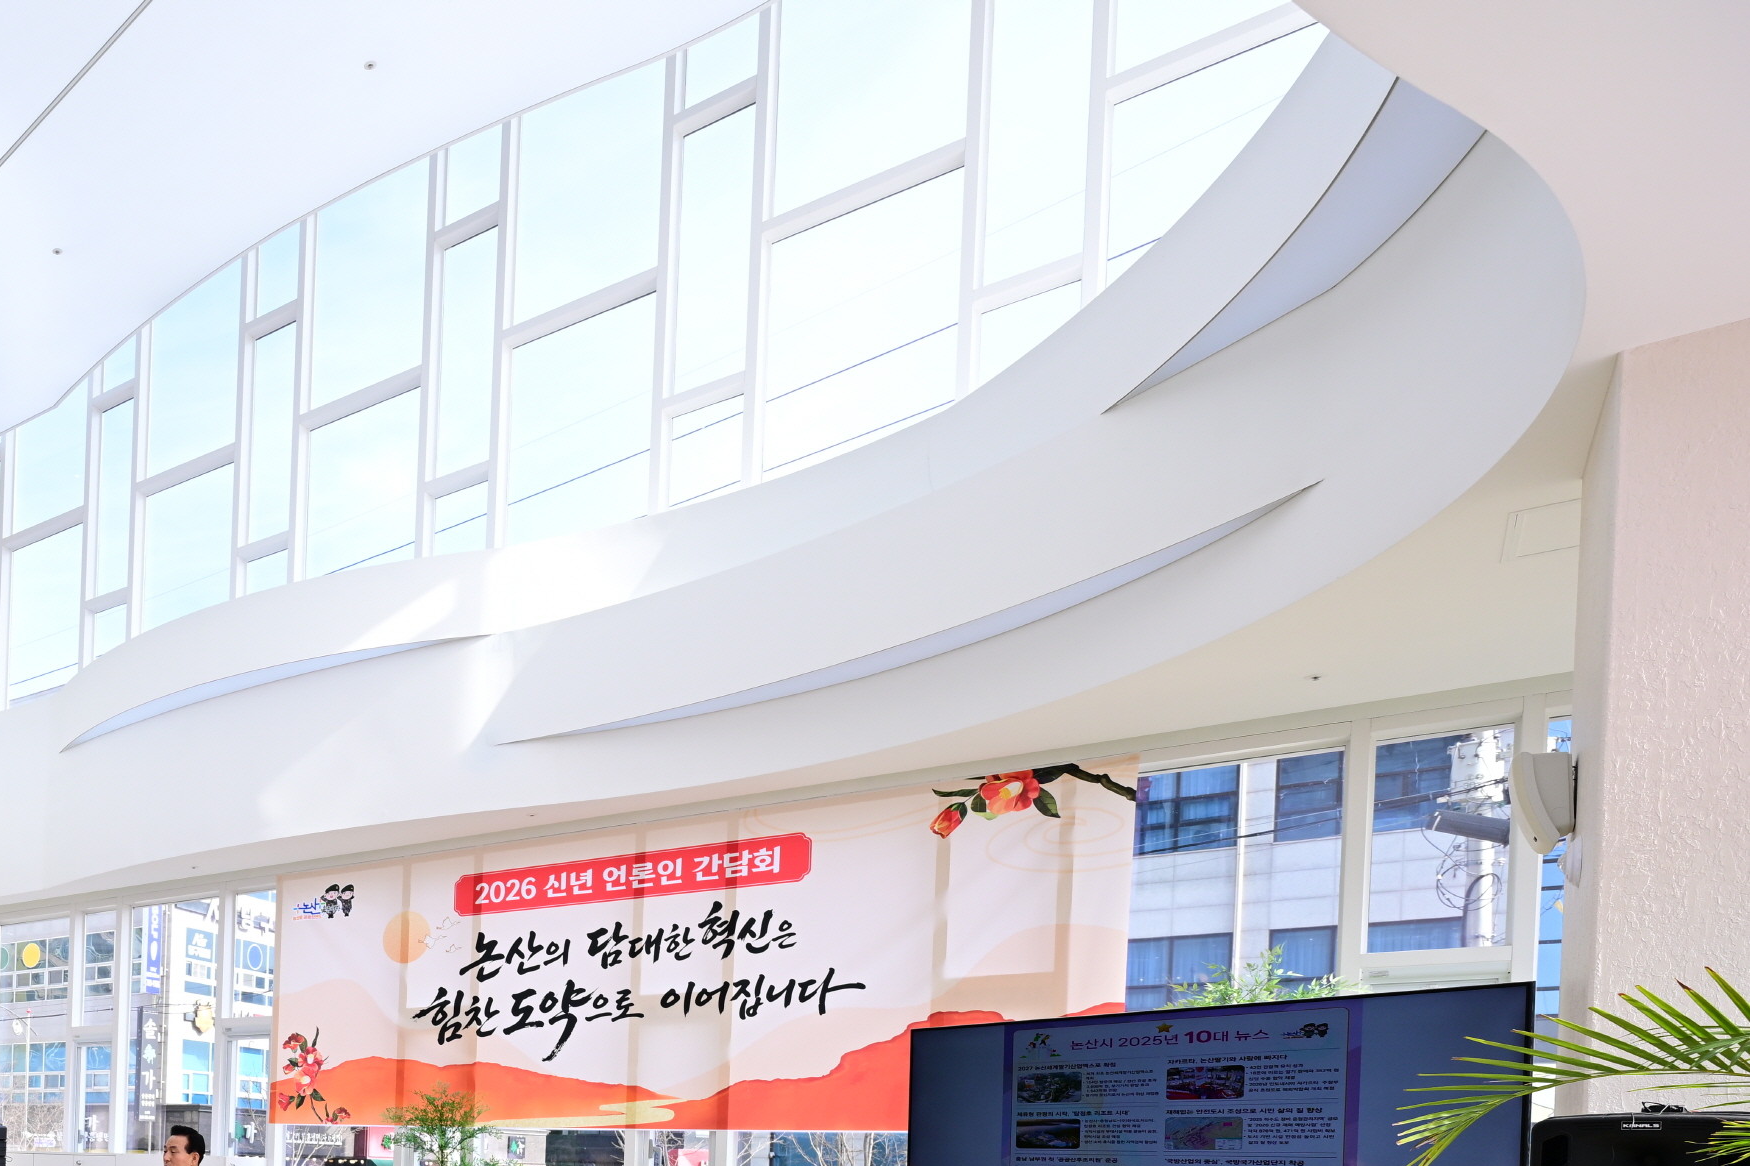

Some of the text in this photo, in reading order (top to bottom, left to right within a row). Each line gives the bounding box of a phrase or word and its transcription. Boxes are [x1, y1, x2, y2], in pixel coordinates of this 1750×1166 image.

[475, 847, 782, 907] 2026 신년 언론인 간담회
[460, 899, 798, 980] 논산의 담대한 혁신은
[143, 1018, 157, 1039] 솔
[412, 969, 865, 1061] 힘찬 도약으로 이어집니다
[1070, 1038, 1112, 1050] 논산시
[1118, 1032, 1178, 1047] 2025년
[1184, 1028, 1228, 1044] 10대
[1234, 1029, 1269, 1041] 뉴스
[141, 1069, 156, 1090] 가
